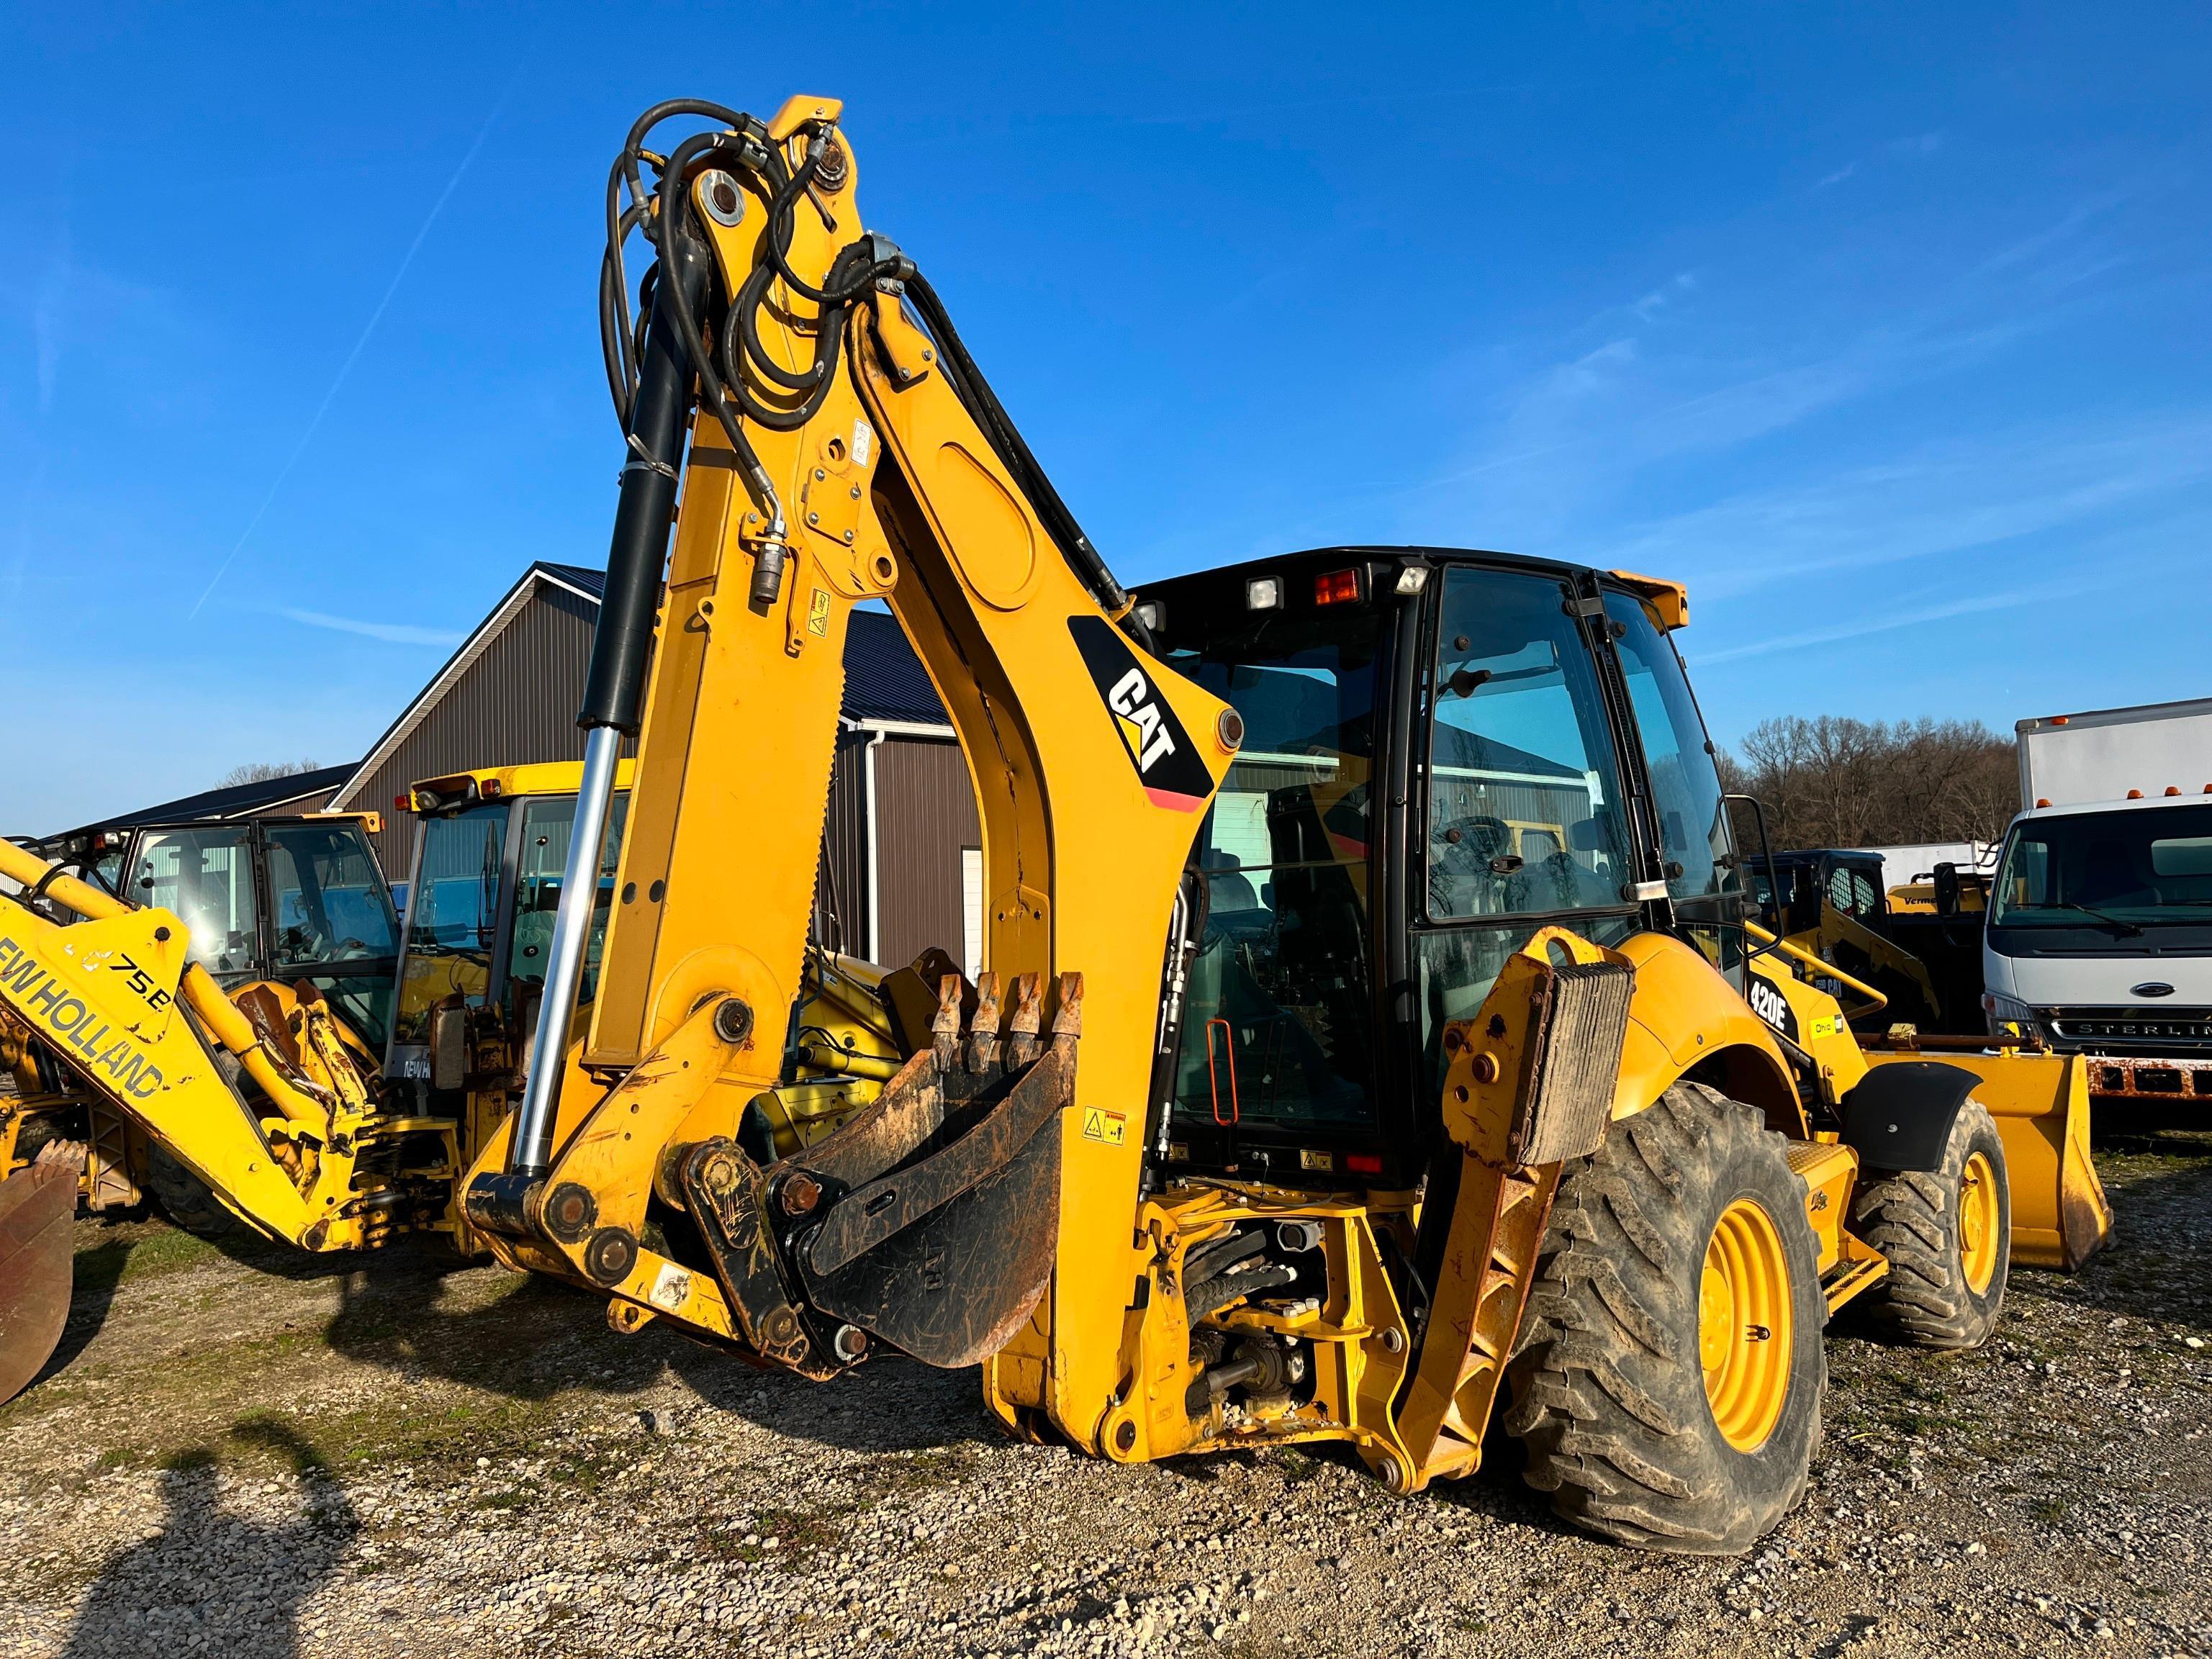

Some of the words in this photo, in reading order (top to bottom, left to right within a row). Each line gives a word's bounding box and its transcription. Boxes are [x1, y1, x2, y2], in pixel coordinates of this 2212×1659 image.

[1109, 668, 1175, 773] CAT
[1751, 981, 1786, 1031] 420E
[1816, 1023, 1831, 1033] Ohio
[27, 979, 163, 1098] HOLLAND
[404, 1061, 423, 1078] NEW
[925, 1244, 944, 1290] CAT
